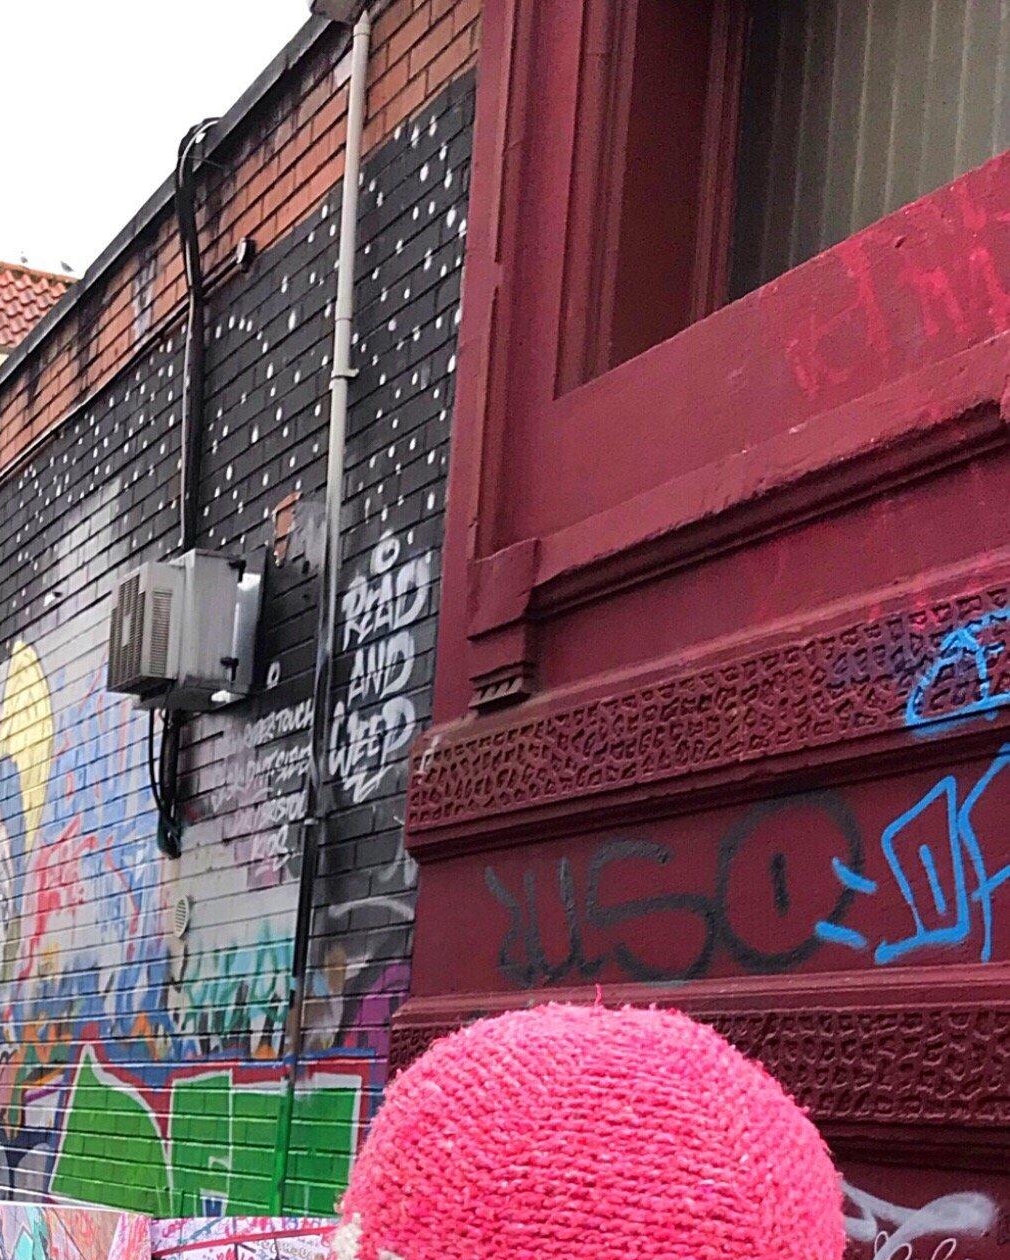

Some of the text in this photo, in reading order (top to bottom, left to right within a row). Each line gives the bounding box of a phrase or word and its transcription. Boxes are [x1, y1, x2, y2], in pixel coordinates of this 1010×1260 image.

[342, 556, 432, 651] READ
[347, 631, 416, 708] AND
[328, 696, 417, 776] WEEP
